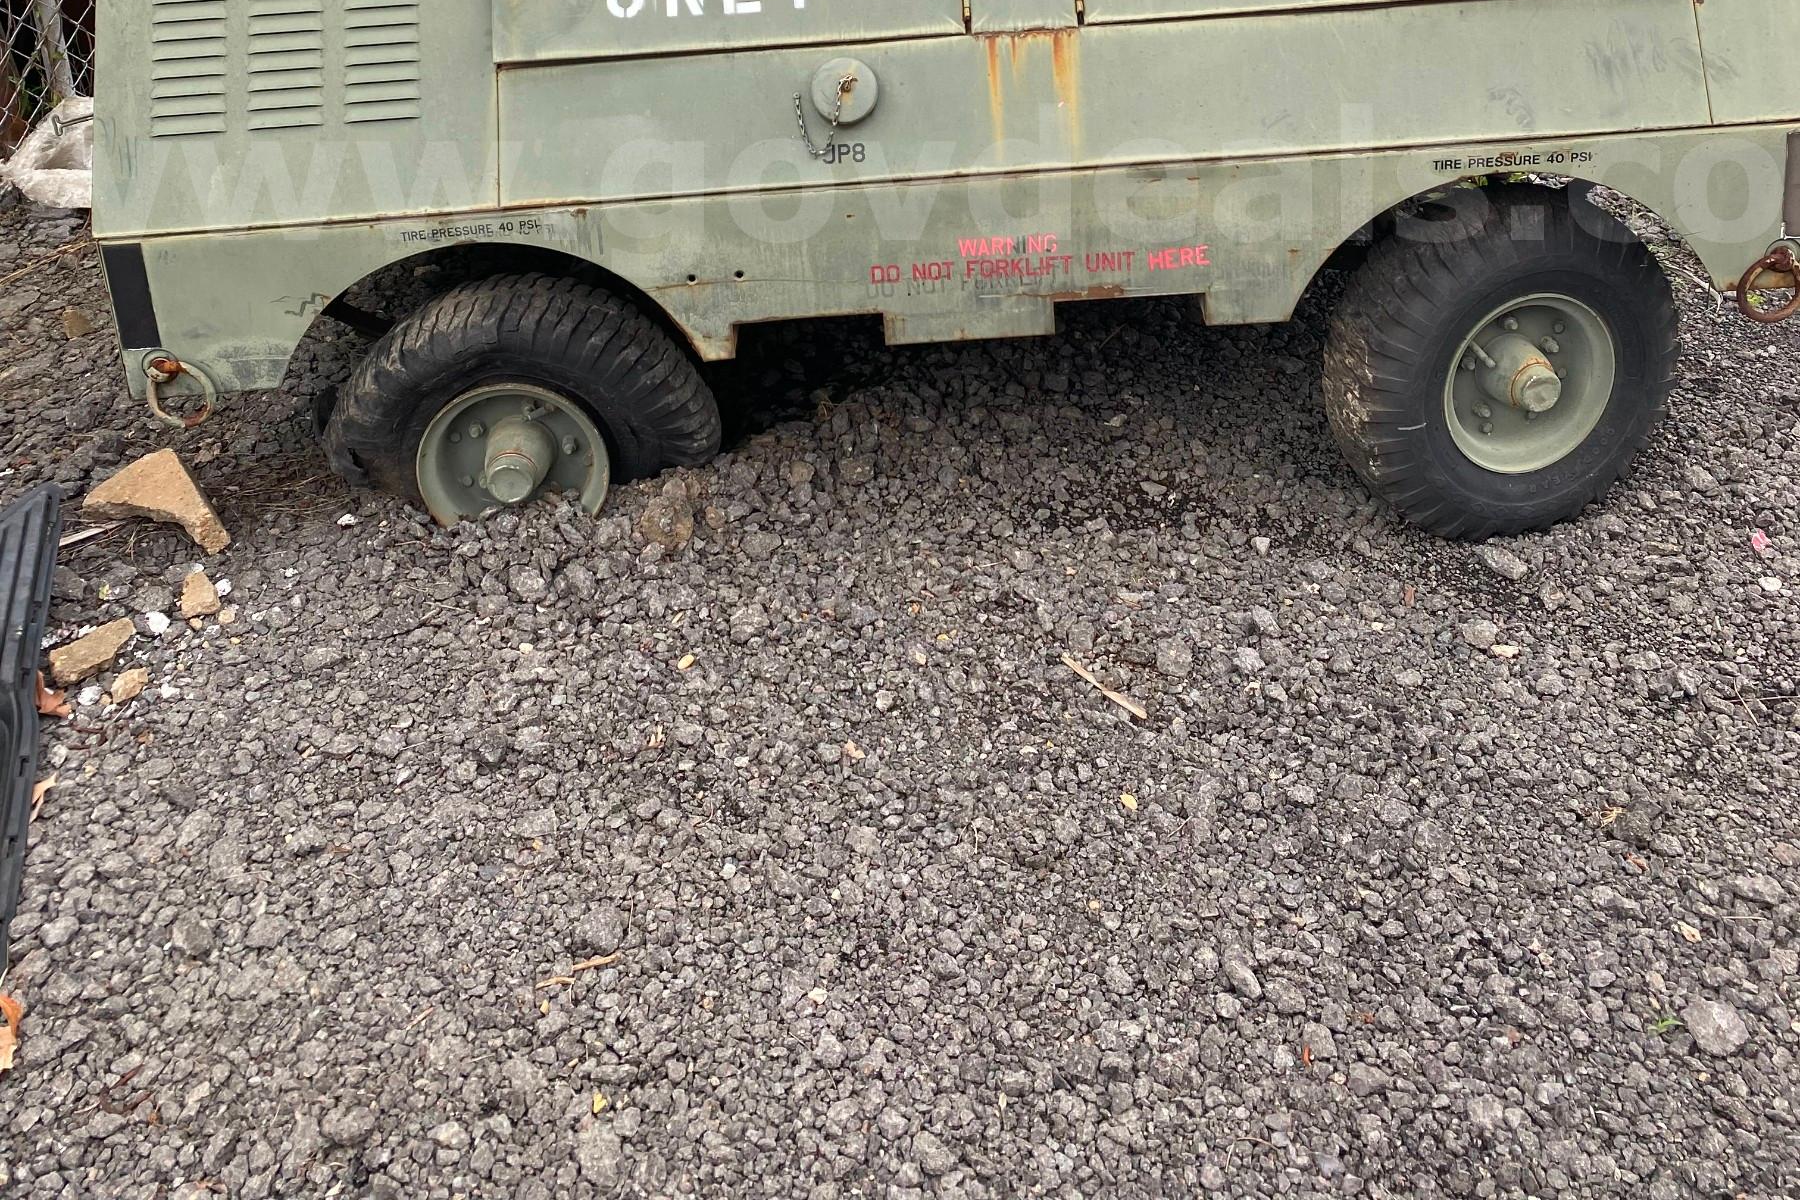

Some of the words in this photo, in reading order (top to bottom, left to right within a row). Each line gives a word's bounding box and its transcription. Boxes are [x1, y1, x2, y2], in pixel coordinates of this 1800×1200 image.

[822, 143, 865, 164] JP8
[1433, 159, 1462, 171] TIRE
[1468, 154, 1541, 168] PRESSURE
[1546, 153, 1565, 164] 40
[1570, 151, 1592, 163] PSI
[400, 230, 426, 242] TIRE
[431, 223, 494, 240] PRESSURE
[499, 221, 514, 232] 40
[519, 219, 541, 230] PSI
[958, 233, 1057, 257] WARNING
[870, 264, 901, 284] DO
[912, 261, 955, 282] NOT
[965, 255, 1073, 280] FORKLIFT
[1085, 251, 1135, 273] UNIT
[1148, 244, 1211, 272] HERE
